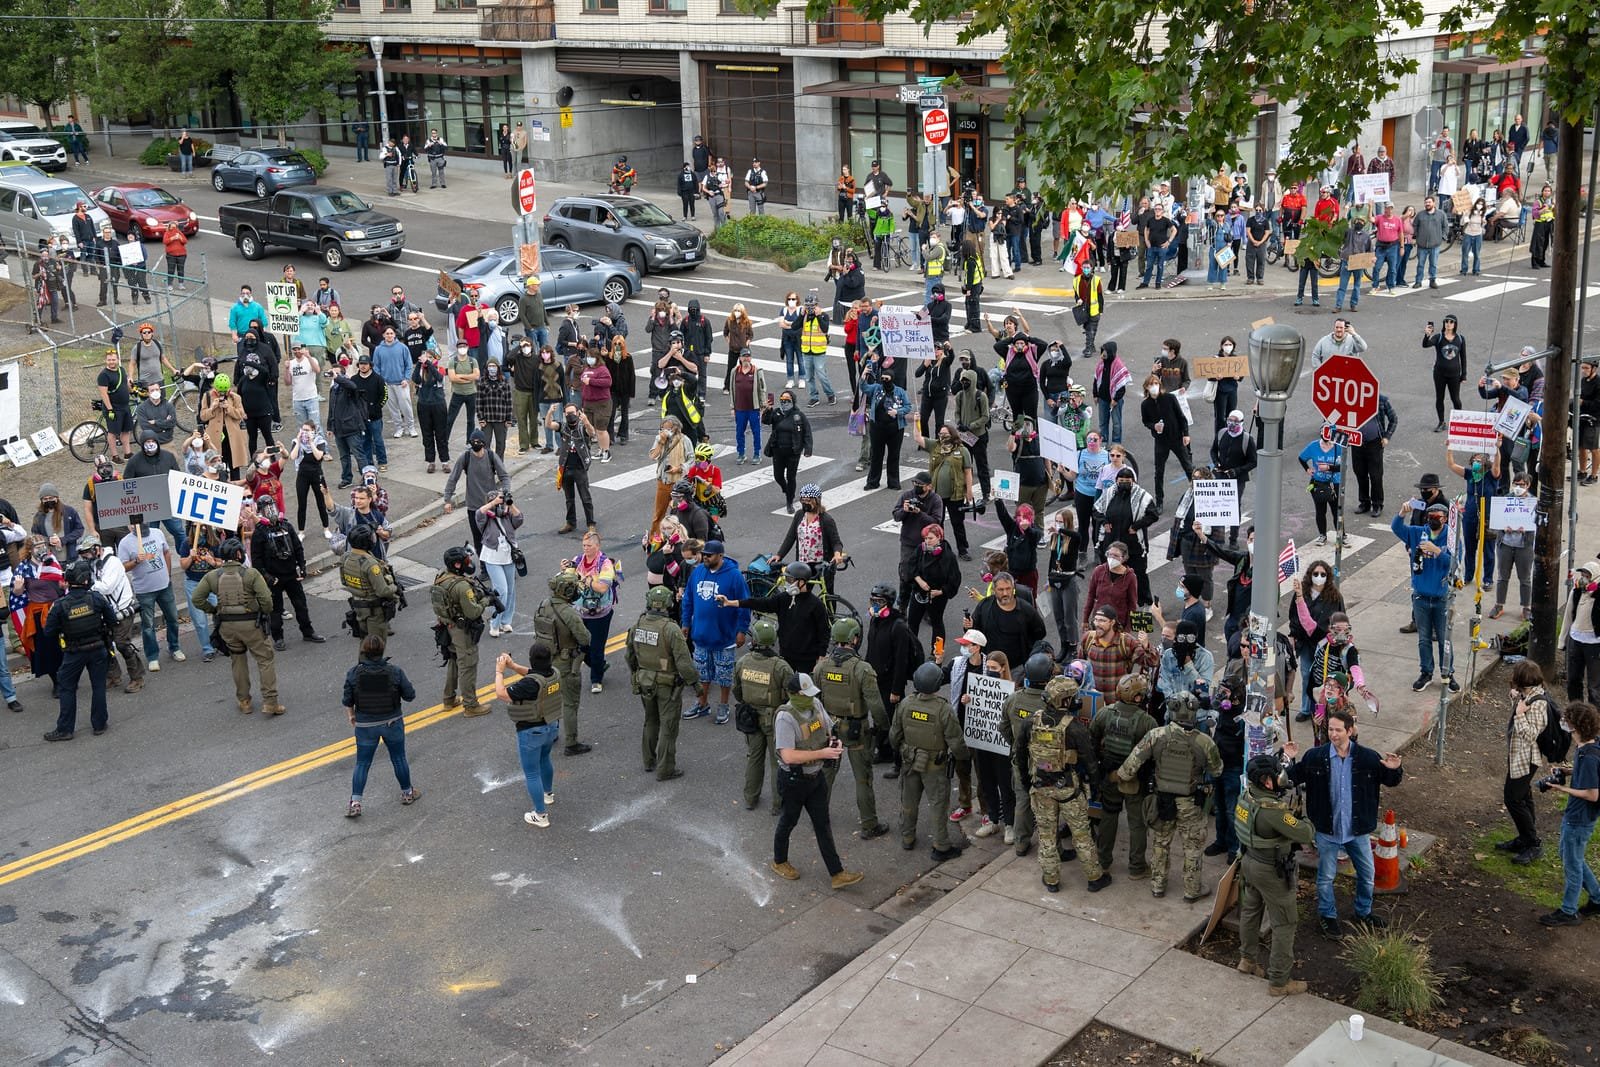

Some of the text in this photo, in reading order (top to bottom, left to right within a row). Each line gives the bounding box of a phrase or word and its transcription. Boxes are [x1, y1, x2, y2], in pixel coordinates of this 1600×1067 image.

[960, 120, 976, 129] 4150
[930, 131, 944, 139] ENTER
[522, 197, 533, 206] ENTER
[268, 286, 296, 296] NOT UR
[272, 314, 299, 323] TRAINING
[882, 316, 900, 330] NO
[272, 323, 298, 332] GROUND
[882, 330, 903, 344] YES
[1317, 375, 1374, 408] STOP
[122, 480, 137, 490] ICE
[182, 477, 228, 494] ABOLISH
[120, 496, 140, 506] NAZI
[1507, 497, 1525, 506] ICE
[99, 503, 159, 518] BROWNSHIRTS
[176, 489, 228, 524] ICE
[344, 574, 361, 585] POLICE
[71, 604, 89, 615] POLICE
[827, 673, 842, 682] POLICE
[547, 682, 560, 694] ERO
[976, 677, 1001, 689] YOUR
[972, 697, 980, 706] IS
[912, 711, 928, 721] POLICE
[968, 717, 987, 728] THAN
[965, 727, 993, 743] ORDERS
